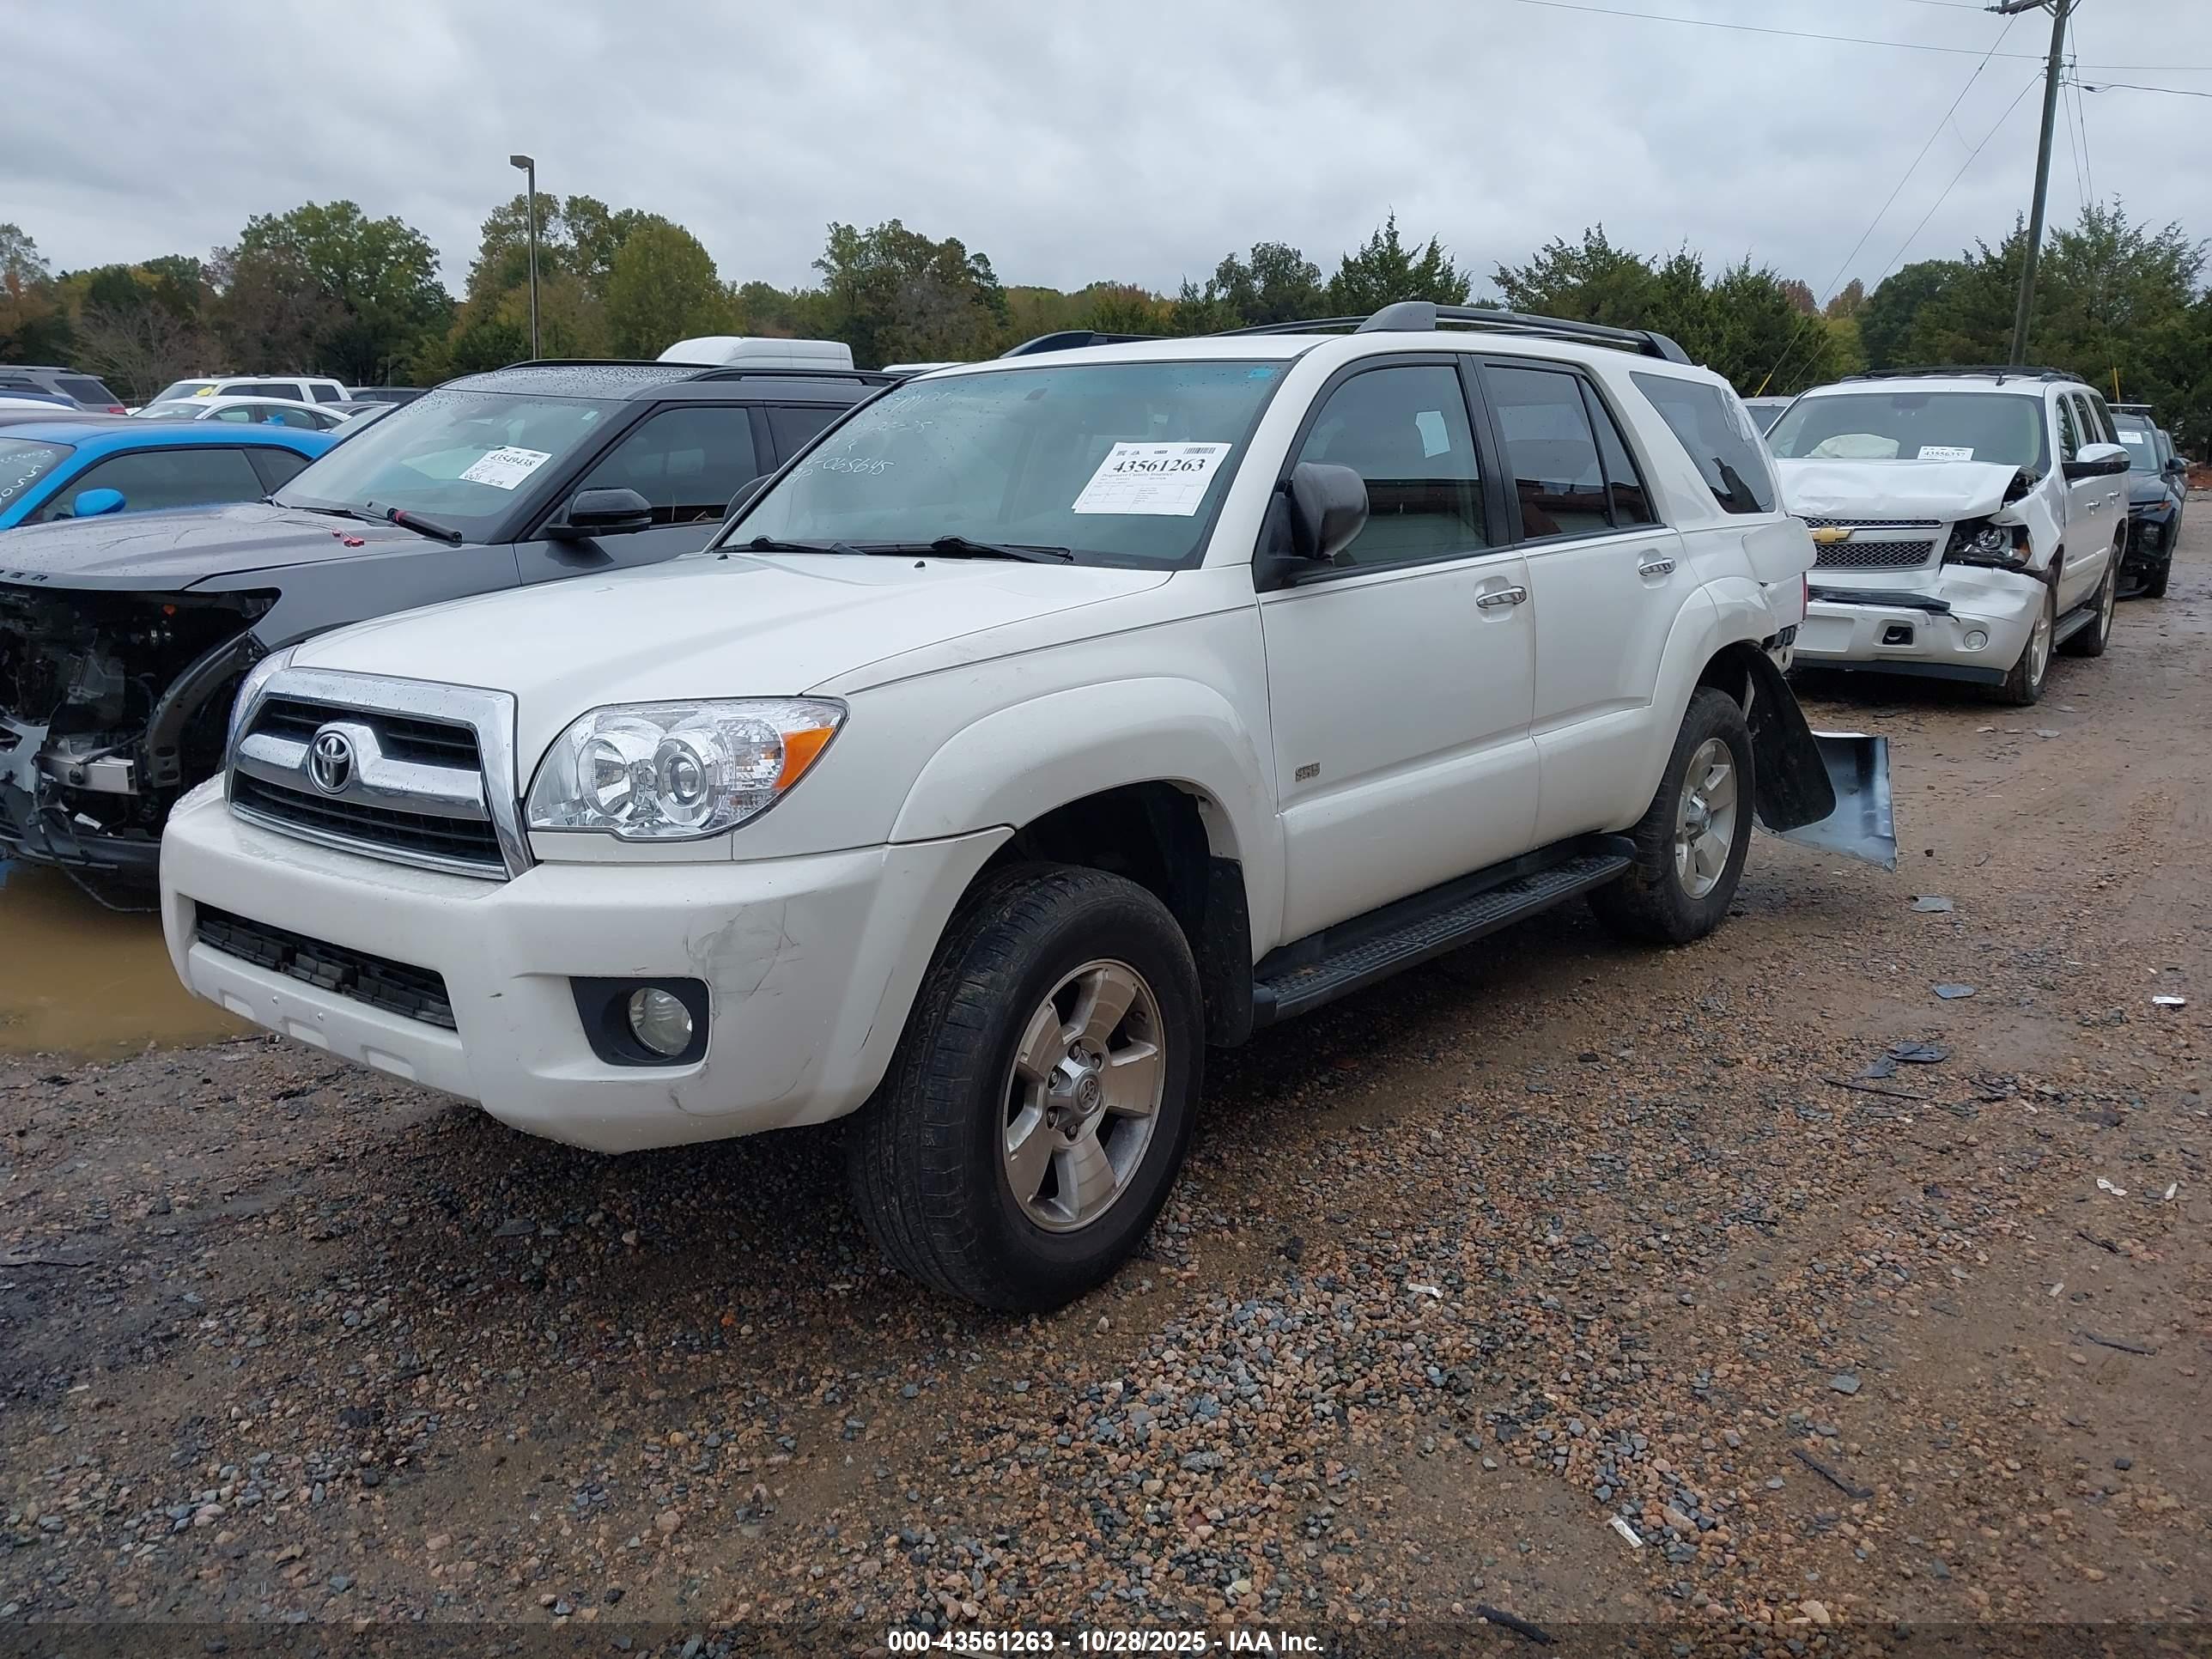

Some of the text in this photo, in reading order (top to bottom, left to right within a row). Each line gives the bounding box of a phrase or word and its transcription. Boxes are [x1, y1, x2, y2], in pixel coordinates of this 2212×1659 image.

[489, 453, 536, 468] 43549438
[1113, 459, 1206, 473] 43561263
[0, 465, 42, 505] 055
